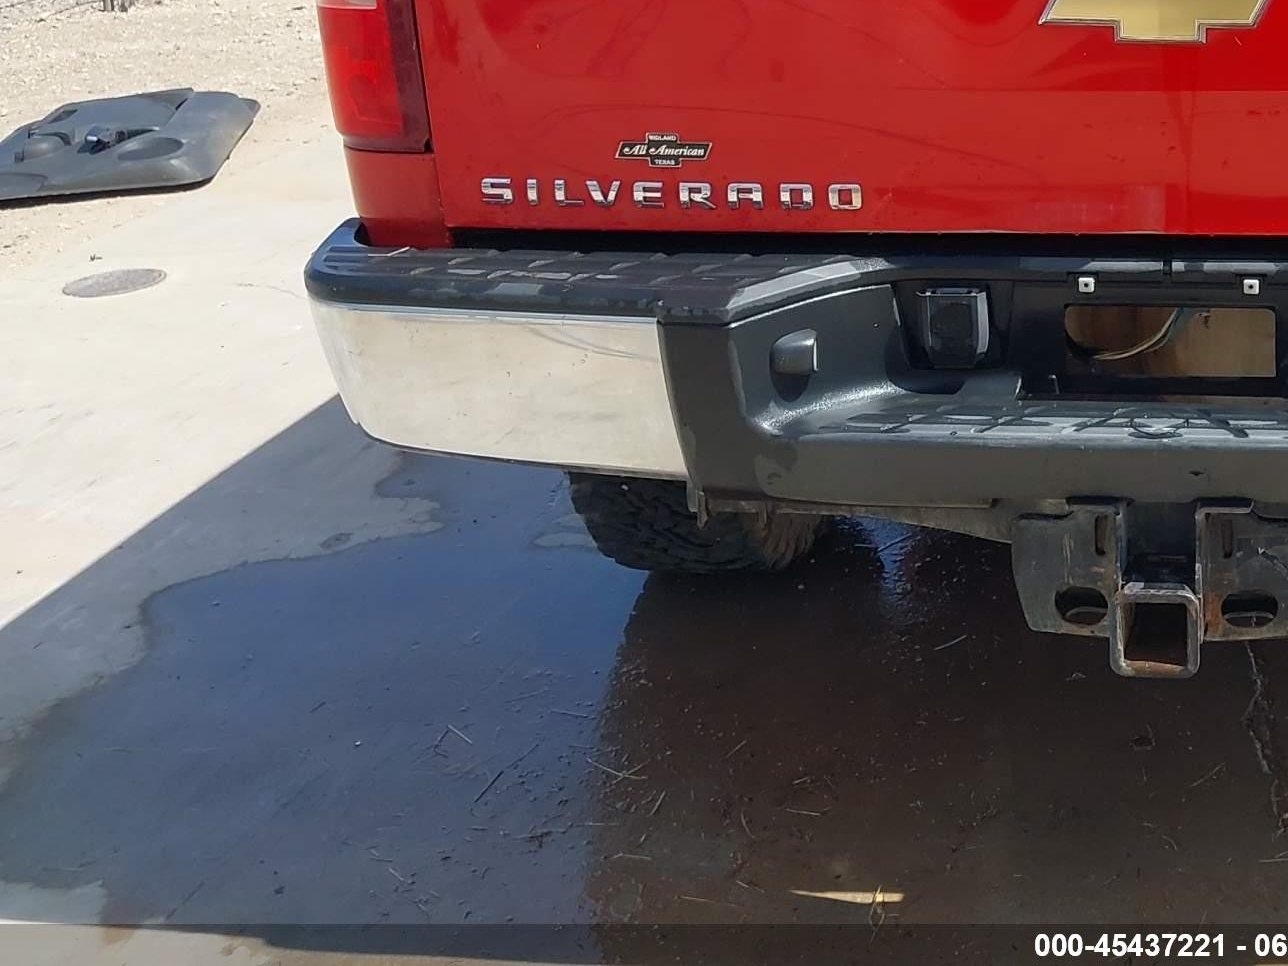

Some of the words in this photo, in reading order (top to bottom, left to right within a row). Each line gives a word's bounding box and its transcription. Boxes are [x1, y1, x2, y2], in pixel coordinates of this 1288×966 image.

[623, 144, 648, 155] All
[648, 144, 705, 156] American
[480, 177, 863, 210] SILVERADO
